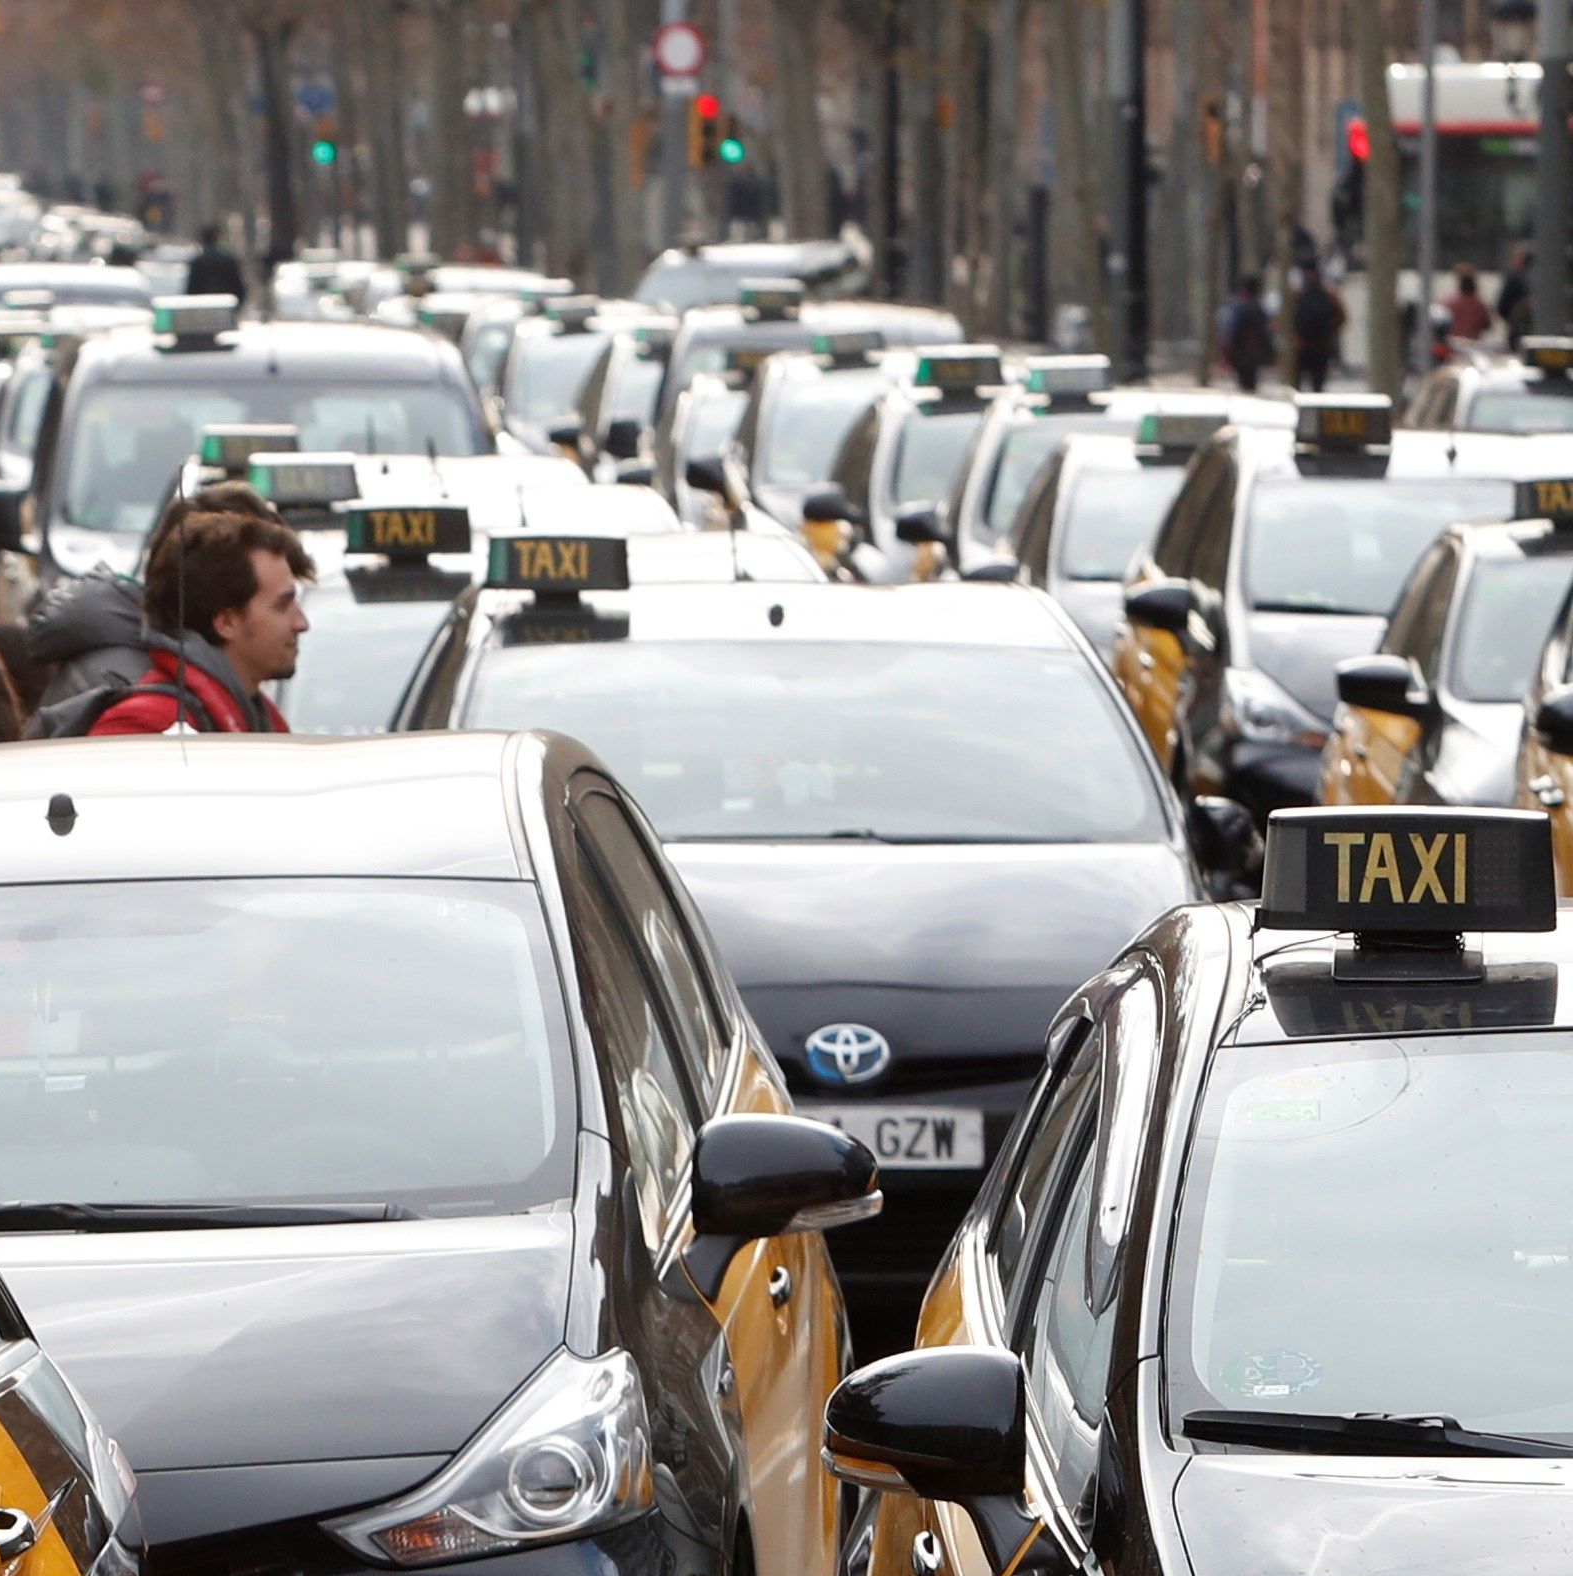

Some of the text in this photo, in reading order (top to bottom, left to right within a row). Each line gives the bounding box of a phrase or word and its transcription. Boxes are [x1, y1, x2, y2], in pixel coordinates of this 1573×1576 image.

[368, 510, 436, 546] TAXI
[514, 539, 591, 580] TAXI
[1323, 832, 1467, 904] TAXI
[876, 1117, 955, 1159] GZW
